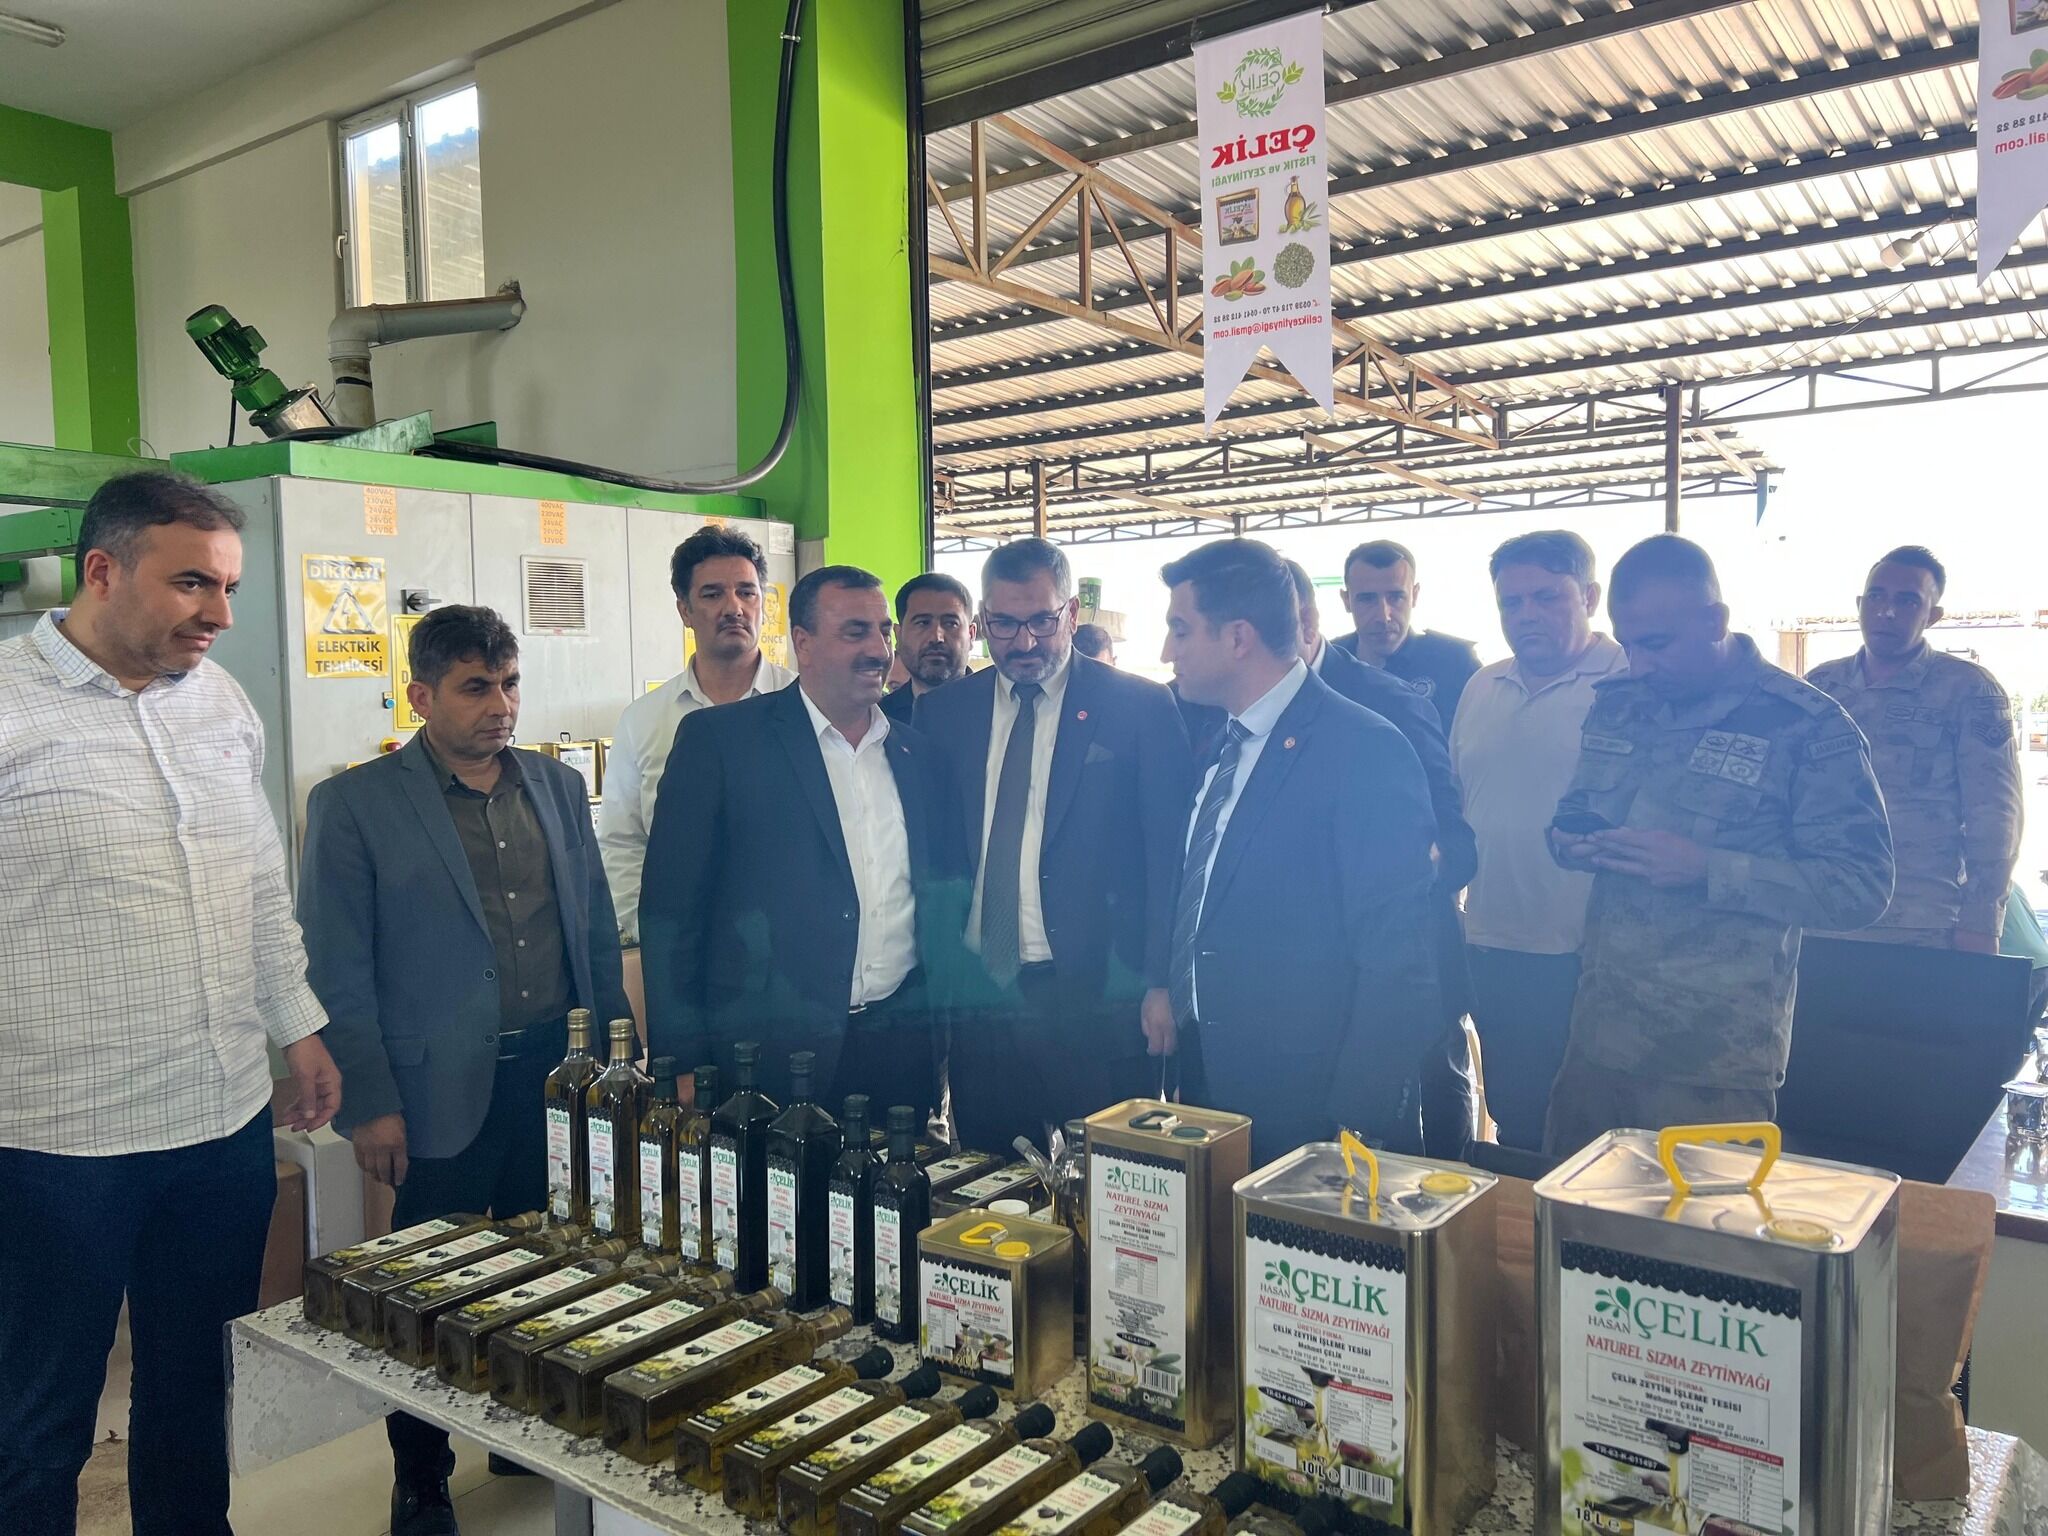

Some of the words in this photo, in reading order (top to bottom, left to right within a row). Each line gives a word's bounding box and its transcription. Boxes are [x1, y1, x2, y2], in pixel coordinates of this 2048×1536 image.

[317, 637, 381, 653] ELEKTRİK
[760, 633, 783, 644] ÖNCE
[1121, 1170, 1171, 1197] ÇELİK
[1105, 1190, 1142, 1209] NATUREL
[1143, 1198, 1169, 1212] SIZMA
[1113, 1203, 1161, 1222] ZEYTİNYAĞI
[949, 1276, 1001, 1301] ÇELİK
[1259, 1282, 1291, 1299] HASAN
[1291, 1268, 1389, 1317] ÇELİK
[1258, 1294, 1299, 1317] NATUREL
[1301, 1306, 1330, 1326] SIZMA
[1332, 1314, 1390, 1340] ZEYTİNYAĞI
[1588, 1315, 1631, 1335] HASAN
[1633, 1296, 1769, 1358] ÇELİK
[1273, 1323, 1292, 1337] ÇELİK
[1294, 1328, 1318, 1343] ZEYTİN
[1319, 1334, 1346, 1350] İŞLEME
[1347, 1342, 1371, 1357] TESİSİ
[1586, 1334, 1643, 1363] NATUREL
[1646, 1349, 1687, 1372] SIZMA
[1690, 1360, 1771, 1393] ZEYTİNYAĞI
[1611, 1372, 1637, 1384] ÇELİK
[1639, 1378, 1671, 1394] ZEYTİN
[1673, 1387, 1709, 1404] İŞLEME
[1711, 1395, 1742, 1413] TESİSİ
[1680, 1400, 1704, 1413] ÇELİK
[1575, 1507, 1591, 1521] 18
